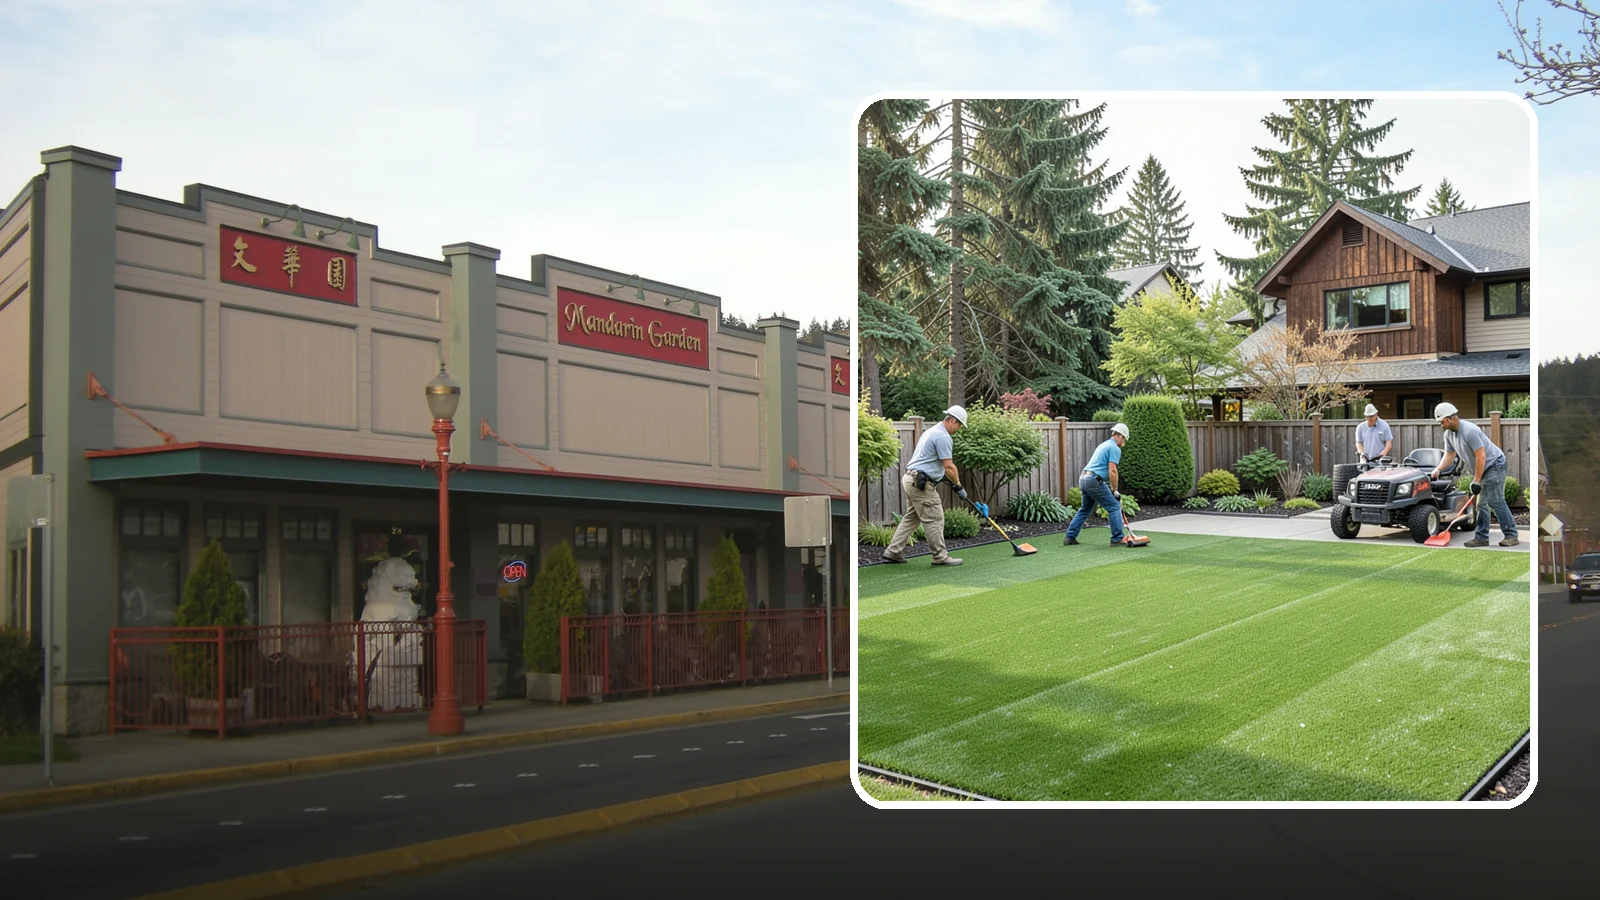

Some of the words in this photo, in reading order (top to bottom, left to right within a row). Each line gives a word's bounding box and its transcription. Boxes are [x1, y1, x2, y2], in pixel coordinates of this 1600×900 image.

[231, 236, 346, 290] 文華園
[564, 302, 644, 341] Mandarin
[648, 320, 701, 352] Garden
[503, 565, 527, 578] OPEN
